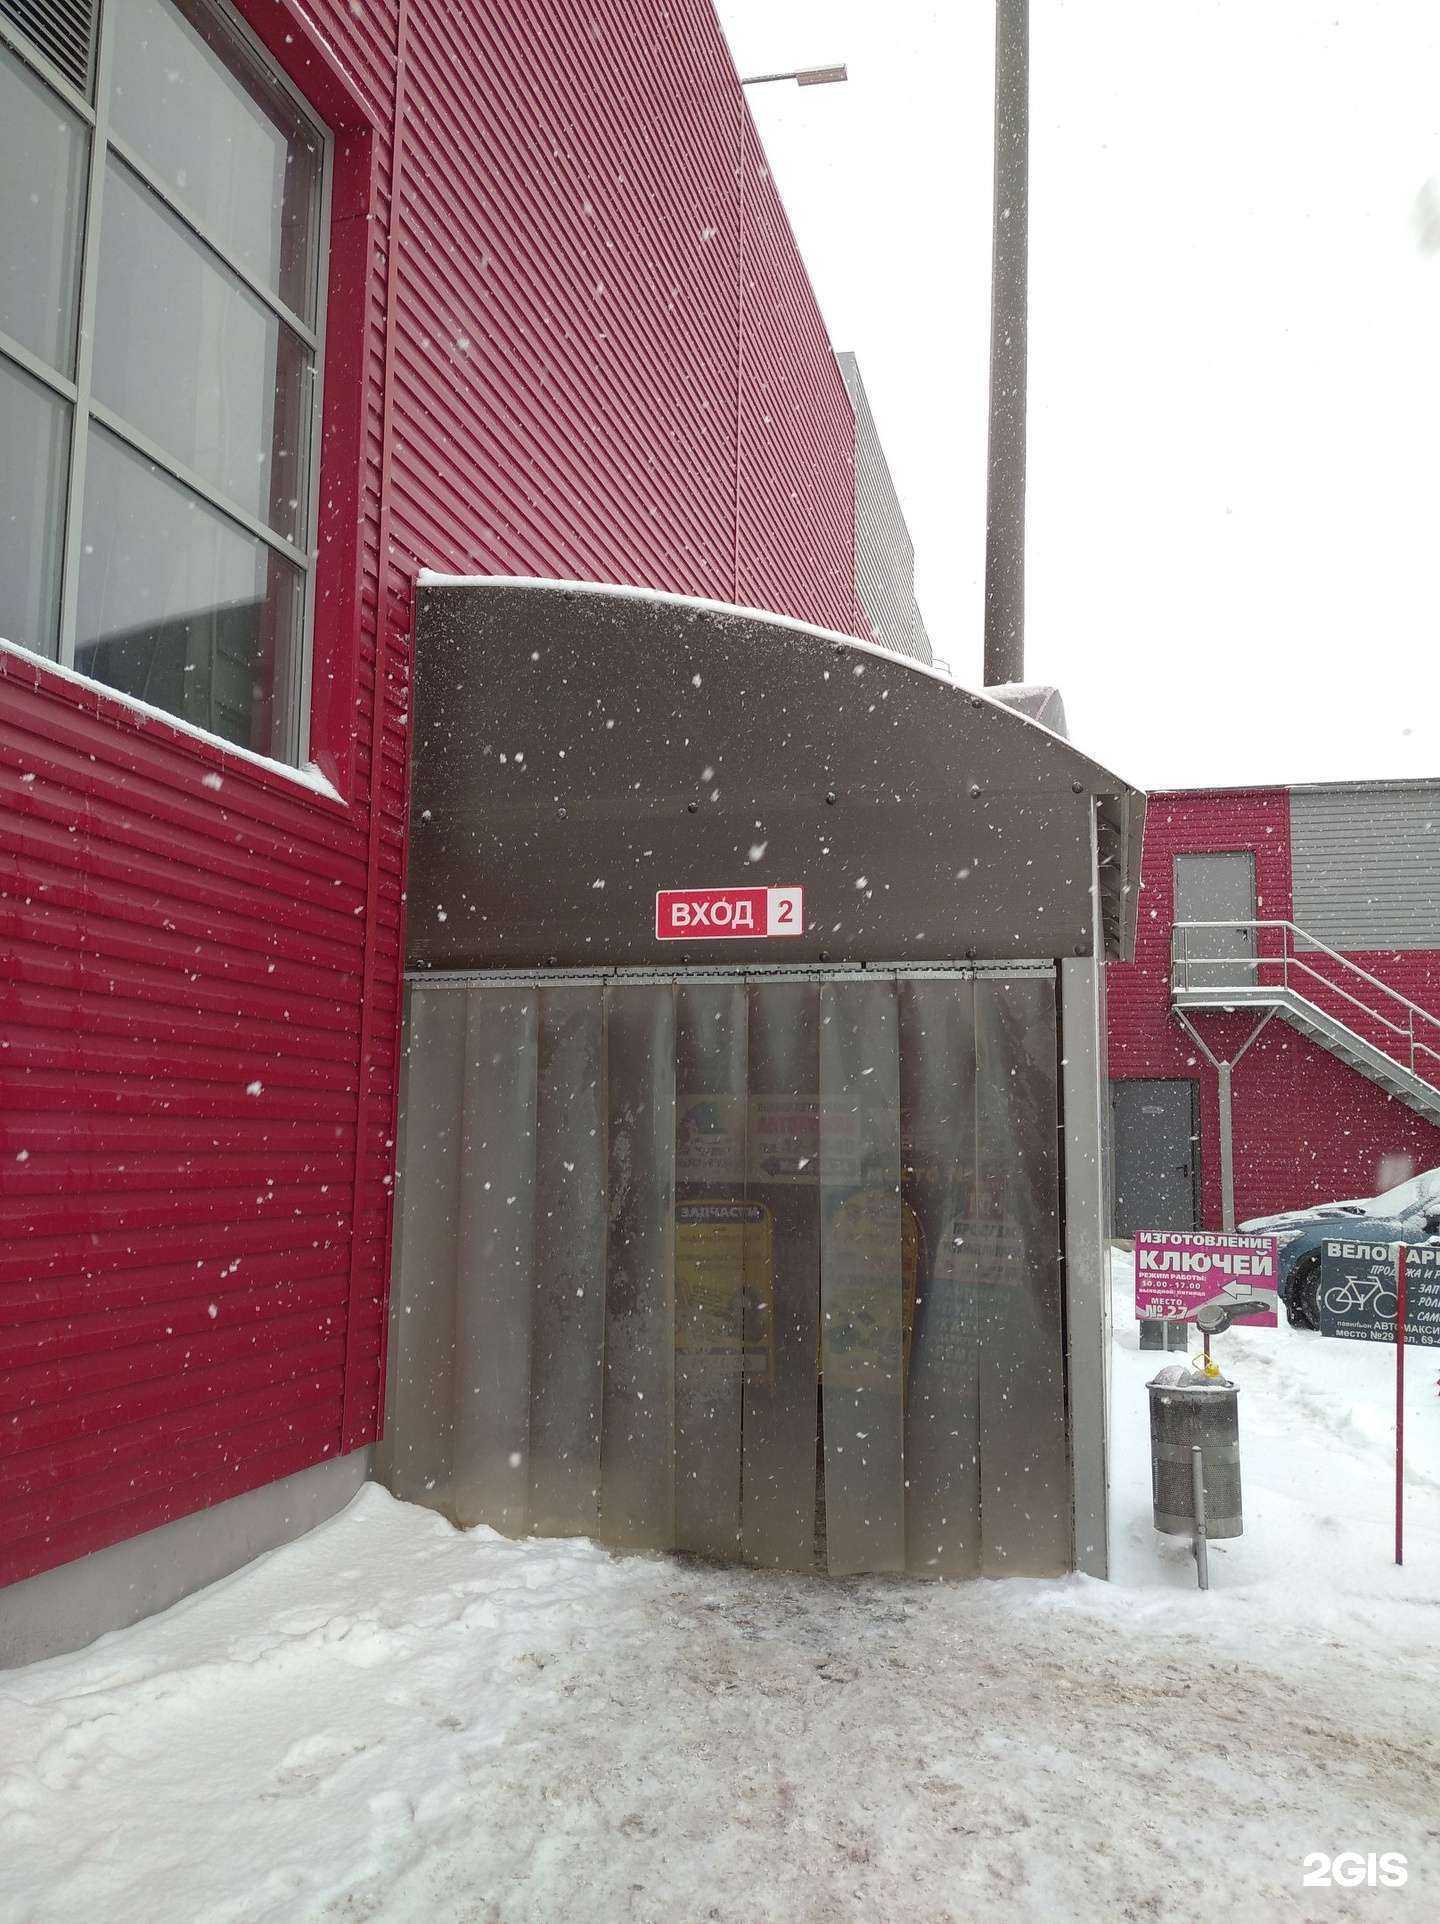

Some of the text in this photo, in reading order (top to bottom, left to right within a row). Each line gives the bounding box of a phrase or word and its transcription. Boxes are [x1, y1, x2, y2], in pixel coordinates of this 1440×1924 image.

[672, 900, 793, 929] ВХОД 2
[1140, 1232, 1272, 1249] ИЗГОТОВЛЕНИЕ
[1139, 1250, 1273, 1276] КЛЮЧЕЙ
[1142, 1280, 1167, 1288] 10.00
[1151, 1297, 1183, 1306] МЕСТО
